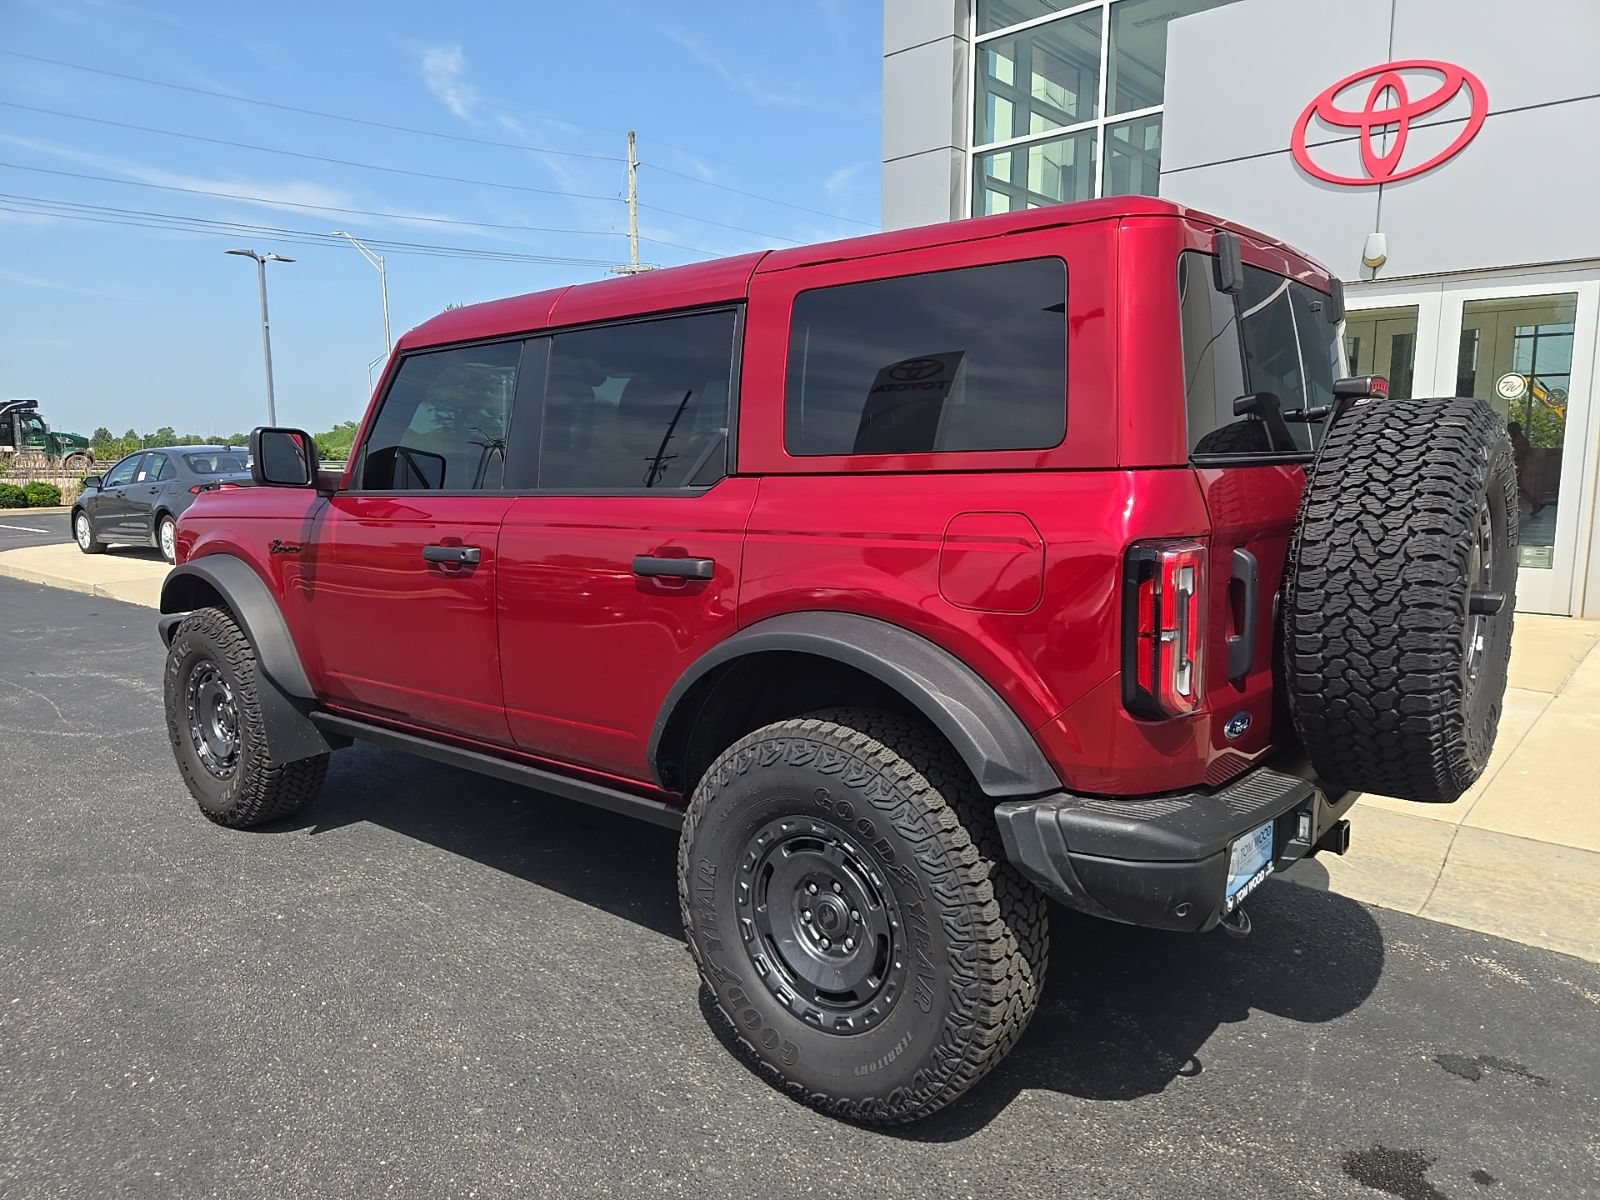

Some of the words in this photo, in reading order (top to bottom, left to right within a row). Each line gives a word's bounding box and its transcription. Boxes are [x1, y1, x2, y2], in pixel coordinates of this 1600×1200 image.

[813, 787, 936, 1014] GOODYEAR
[1236, 885, 1248, 904] TOM
[1248, 870, 1265, 893] WOOD
[696, 858, 800, 1066] GOODYEAR
[854, 1031, 913, 1077] TERRITORY
